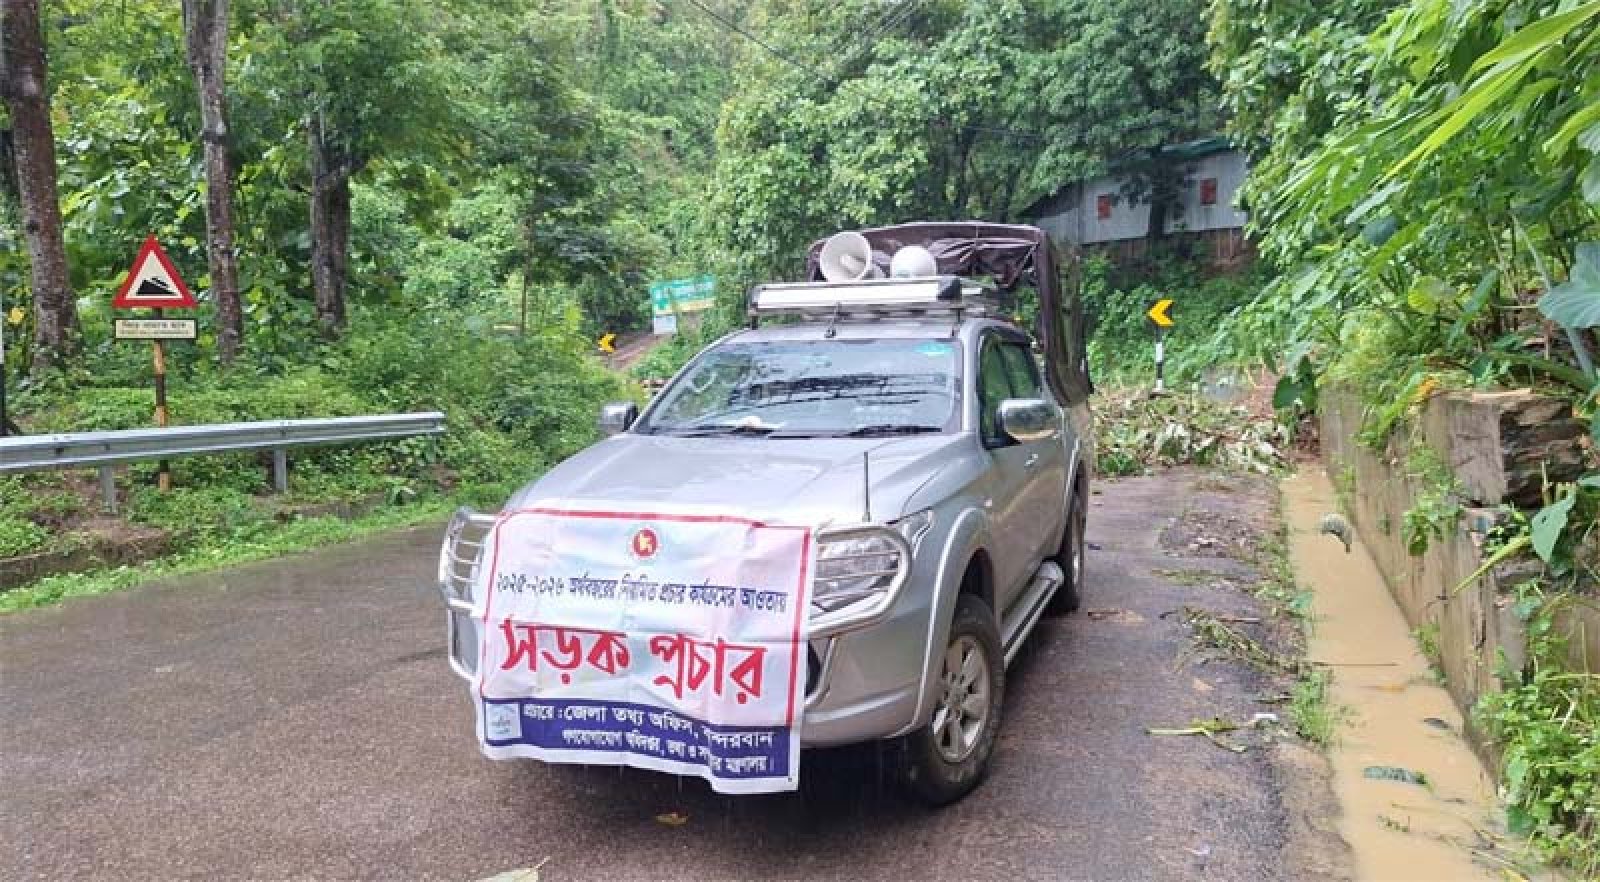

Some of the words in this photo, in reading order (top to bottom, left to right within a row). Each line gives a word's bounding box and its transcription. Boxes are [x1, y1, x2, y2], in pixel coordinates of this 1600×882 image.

[497, 571, 565, 596] ২০২৫-২০২৬
[569, 570, 619, 599] অর্থবছরের
[620, 572, 659, 602] নিয়মিত
[660, 582, 687, 605] প্রচার
[740, 587, 789, 613] আওতায়
[499, 614, 631, 685] সড়ক
[649, 632, 768, 705] প্রচার
[564, 705, 608, 724] জেলা
[611, 706, 645, 726] তথ্য
